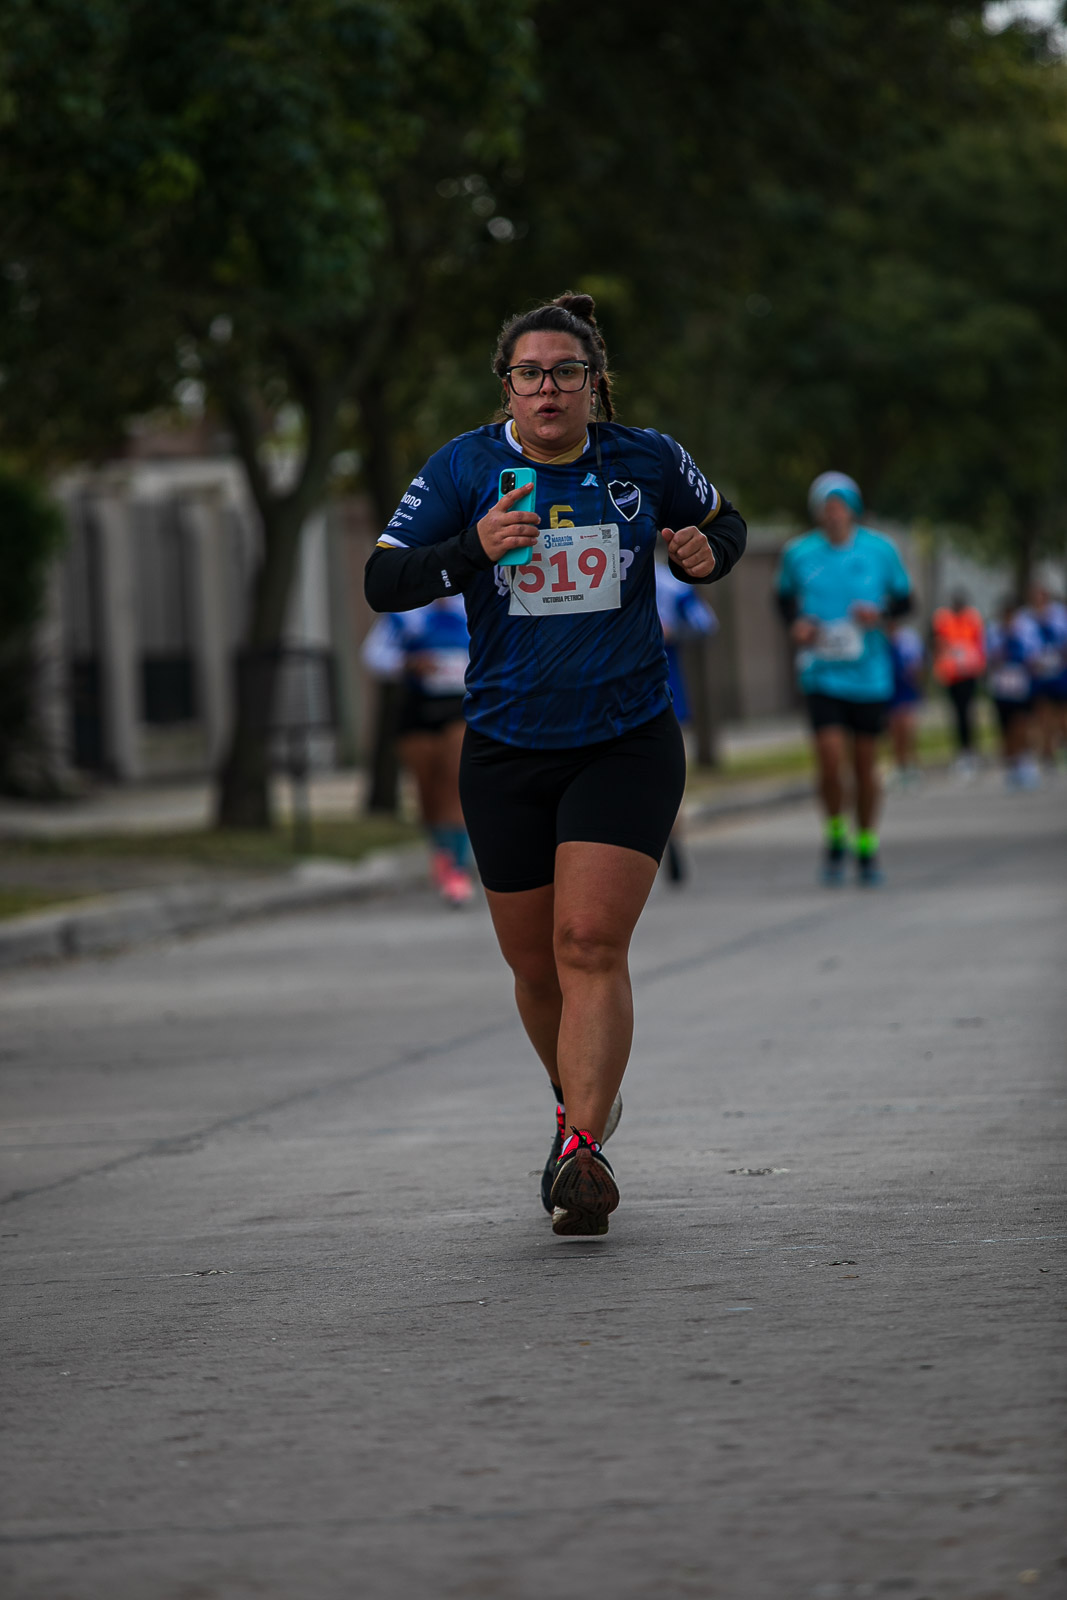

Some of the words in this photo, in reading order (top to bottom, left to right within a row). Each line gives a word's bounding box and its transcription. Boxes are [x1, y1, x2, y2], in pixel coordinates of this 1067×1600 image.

[543, 534, 551, 549] 3
[517, 547, 608, 594] 519
[542, 595, 563, 603] VICTORIA
[564, 594, 584, 602] PETRICH
